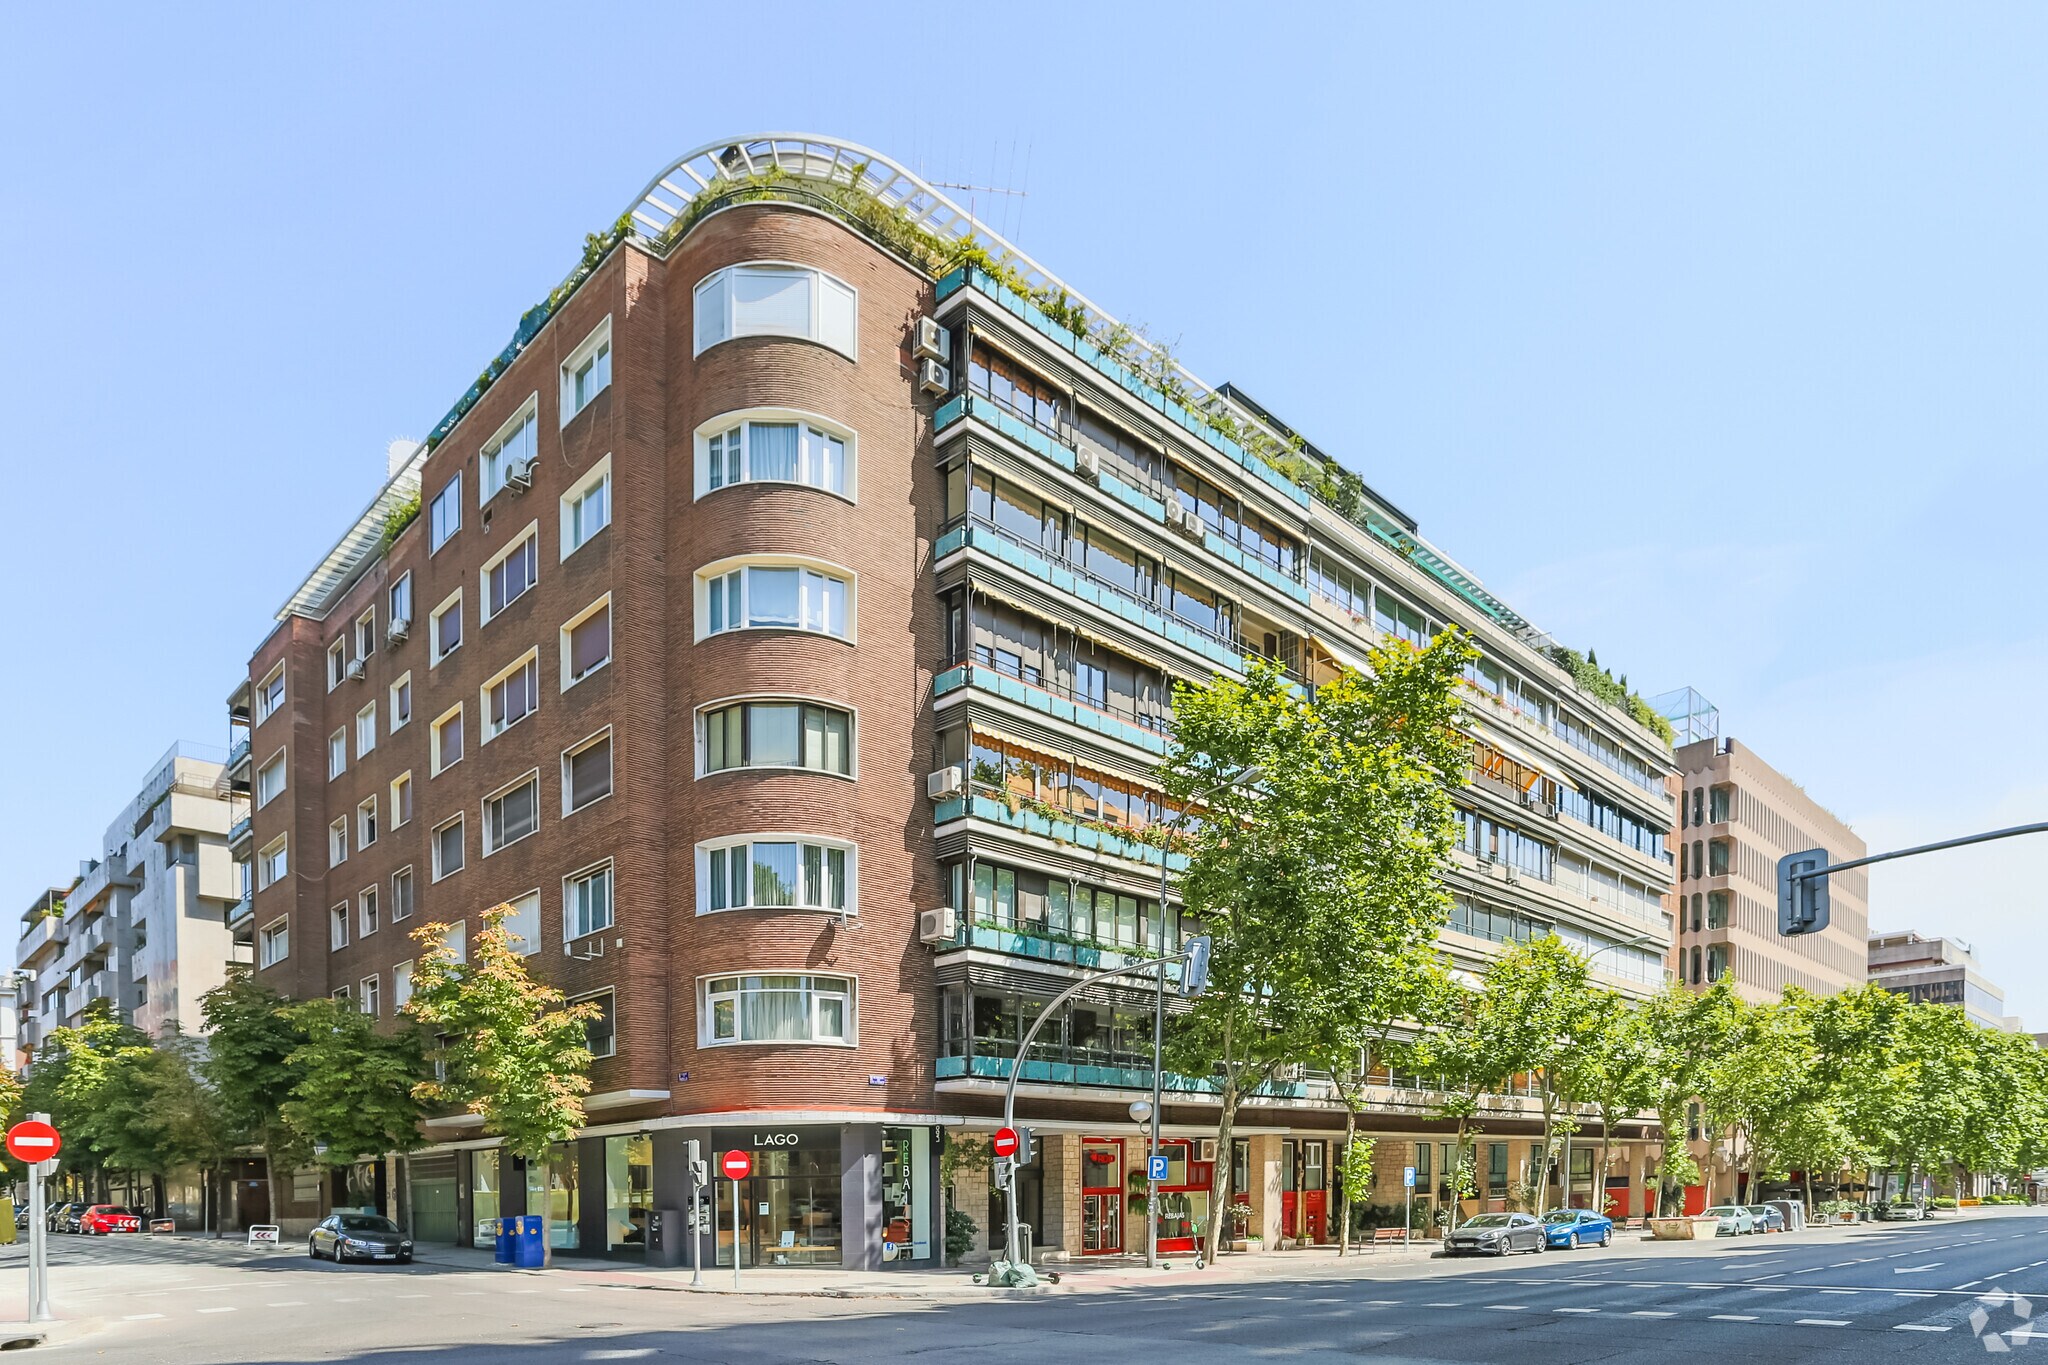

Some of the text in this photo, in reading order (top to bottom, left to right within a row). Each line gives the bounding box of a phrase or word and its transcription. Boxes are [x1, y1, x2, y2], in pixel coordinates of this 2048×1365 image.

[754, 1133, 799, 1146] LAGO
[1153, 1159, 1165, 1177] P
[1406, 1170, 1413, 1184] P
[1164, 1212, 1185, 1220] REBAJAS
